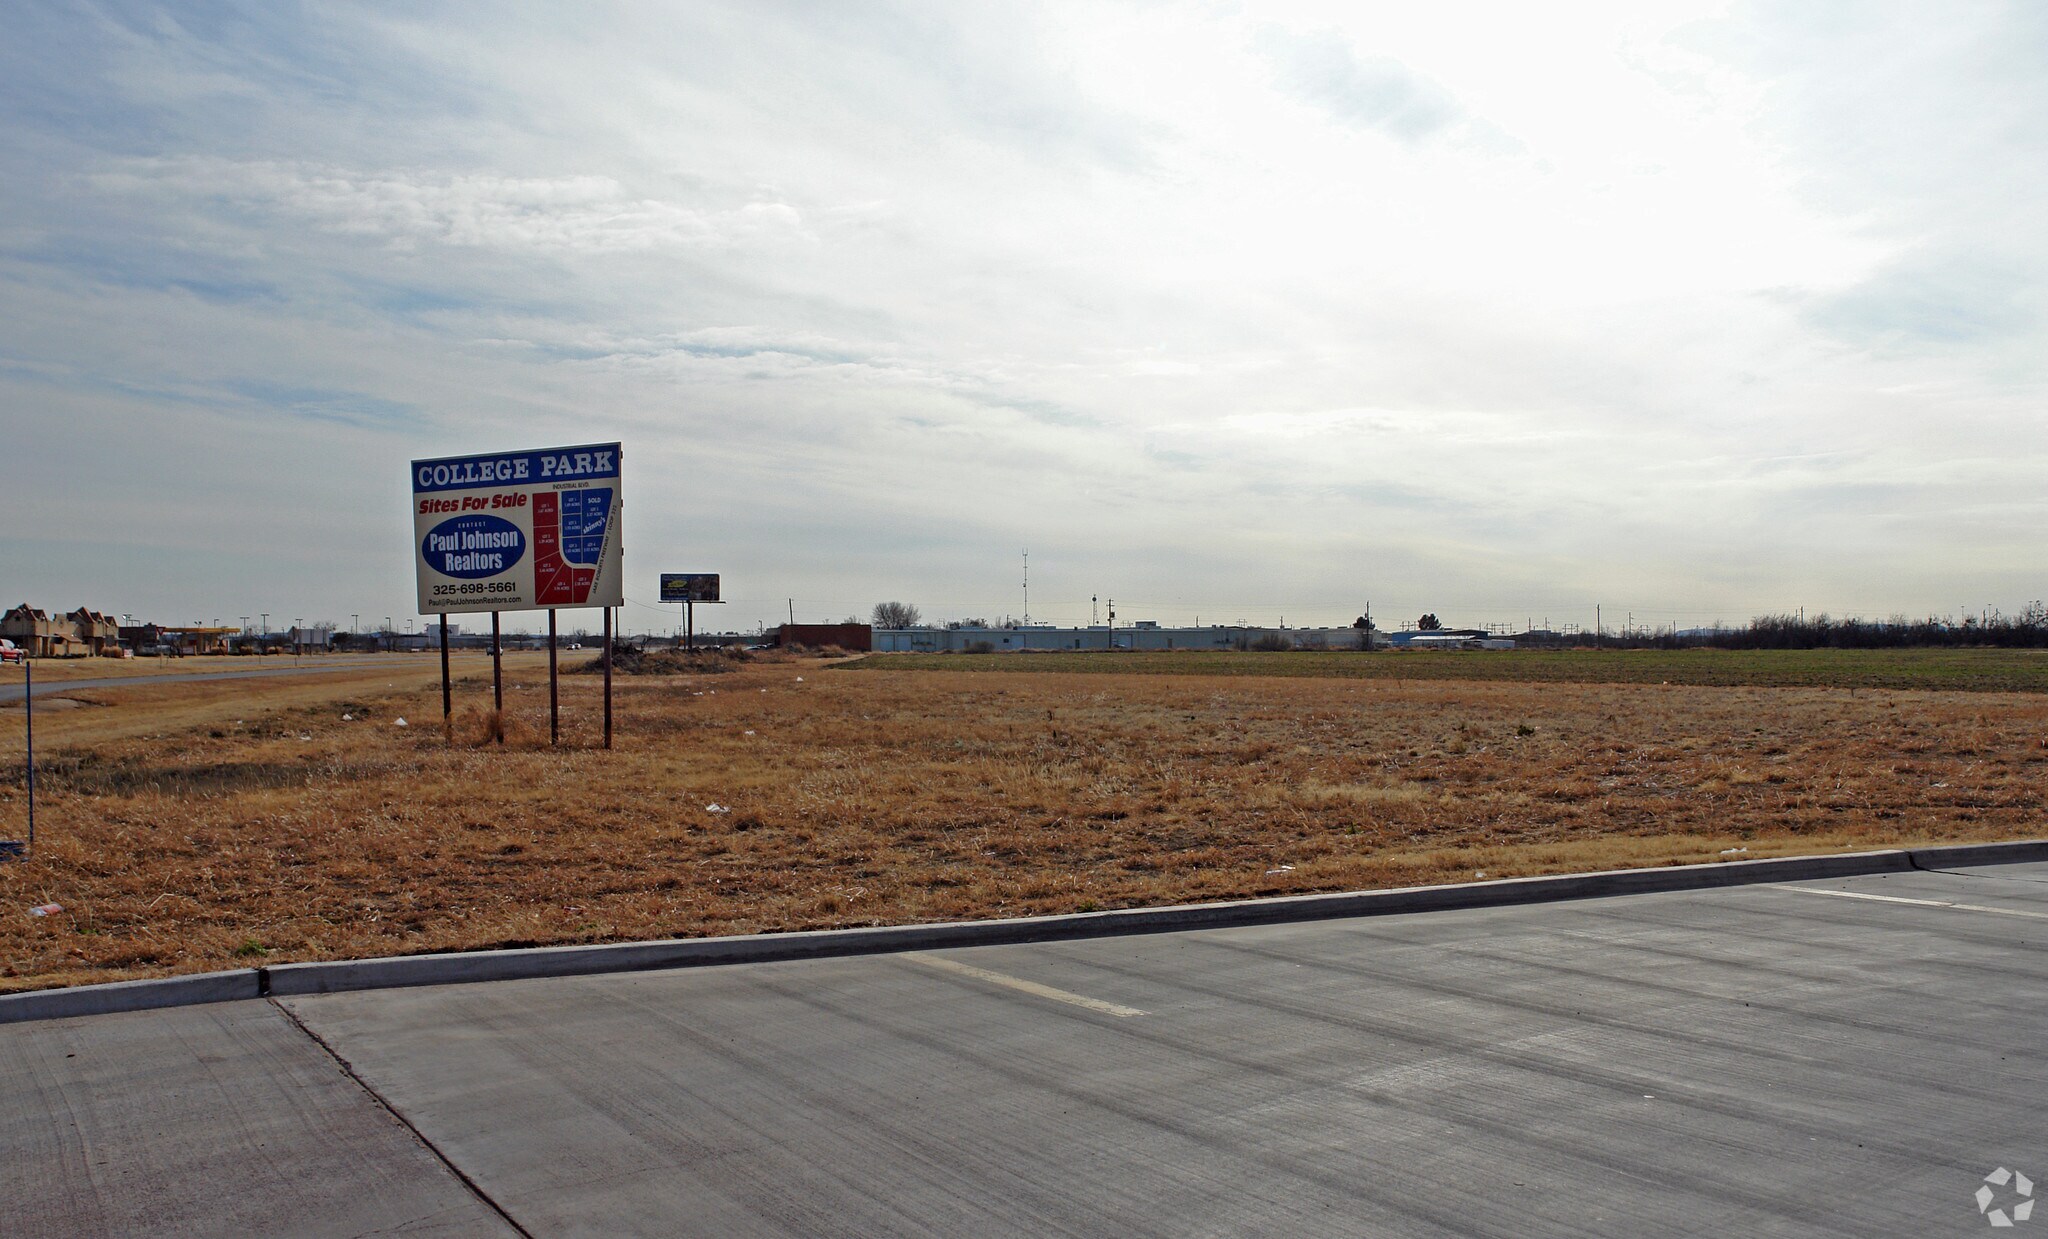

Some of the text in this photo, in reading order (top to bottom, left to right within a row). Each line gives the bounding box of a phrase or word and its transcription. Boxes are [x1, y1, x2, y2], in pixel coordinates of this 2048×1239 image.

[418, 451, 613, 487] COLLEGE PARK
[419, 492, 527, 514] Sites For Sale
[430, 530, 518, 552] Paul Johnson
[445, 552, 502, 571] Realtors
[433, 582, 516, 595] 325-698-5661
[428, 596, 522, 607] Paul@PaulJohnsonRealtors.com
